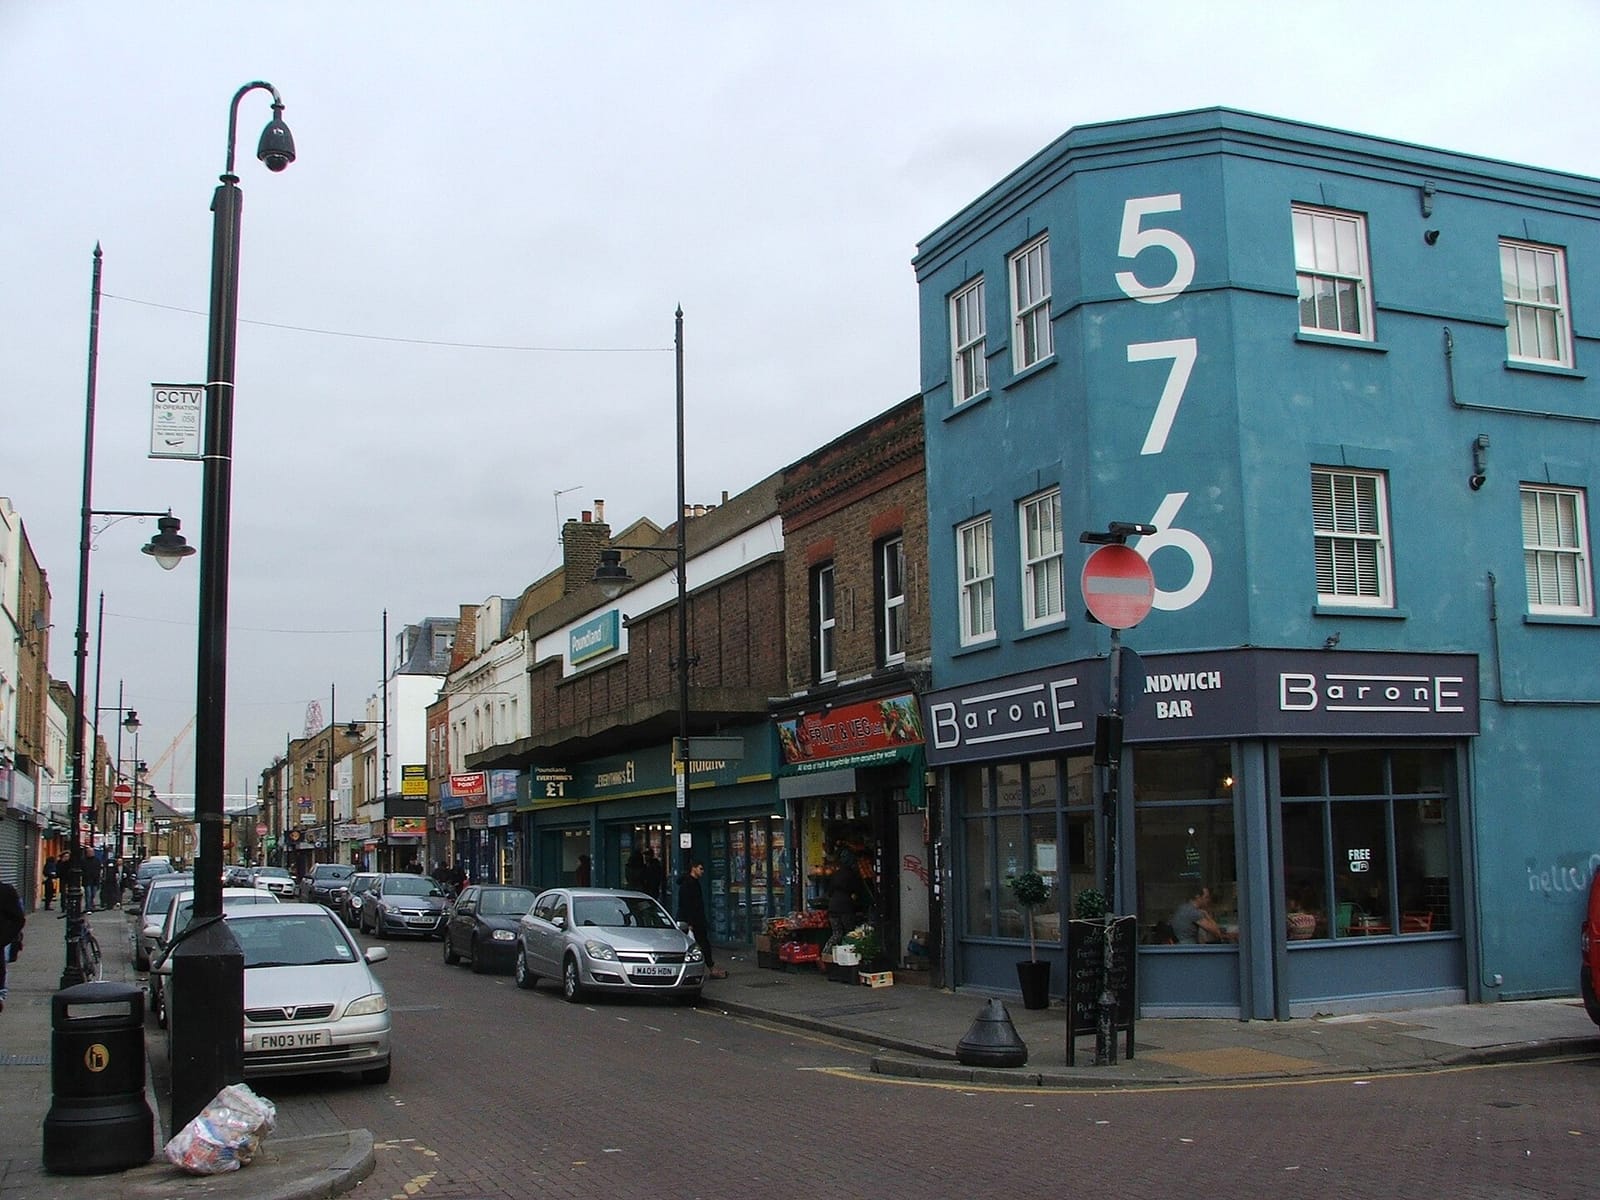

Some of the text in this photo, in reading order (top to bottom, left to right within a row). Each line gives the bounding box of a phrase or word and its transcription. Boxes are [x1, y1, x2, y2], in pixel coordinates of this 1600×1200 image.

[156, 391, 199, 403] CCTV
[572, 624, 602, 653] Poundland
[1144, 671, 1221, 693] NDWICH
[1280, 673, 1464, 712] BaronE
[930, 677, 1083, 749] BaronE
[1156, 700, 1193, 719] BAR
[808, 723, 836, 744] FRUIT
[847, 716, 871, 738] VEG
[546, 782, 564, 797] £1
[1348, 849, 1370, 860] FREE
[261, 1033, 321, 1048] FN03 YHF
